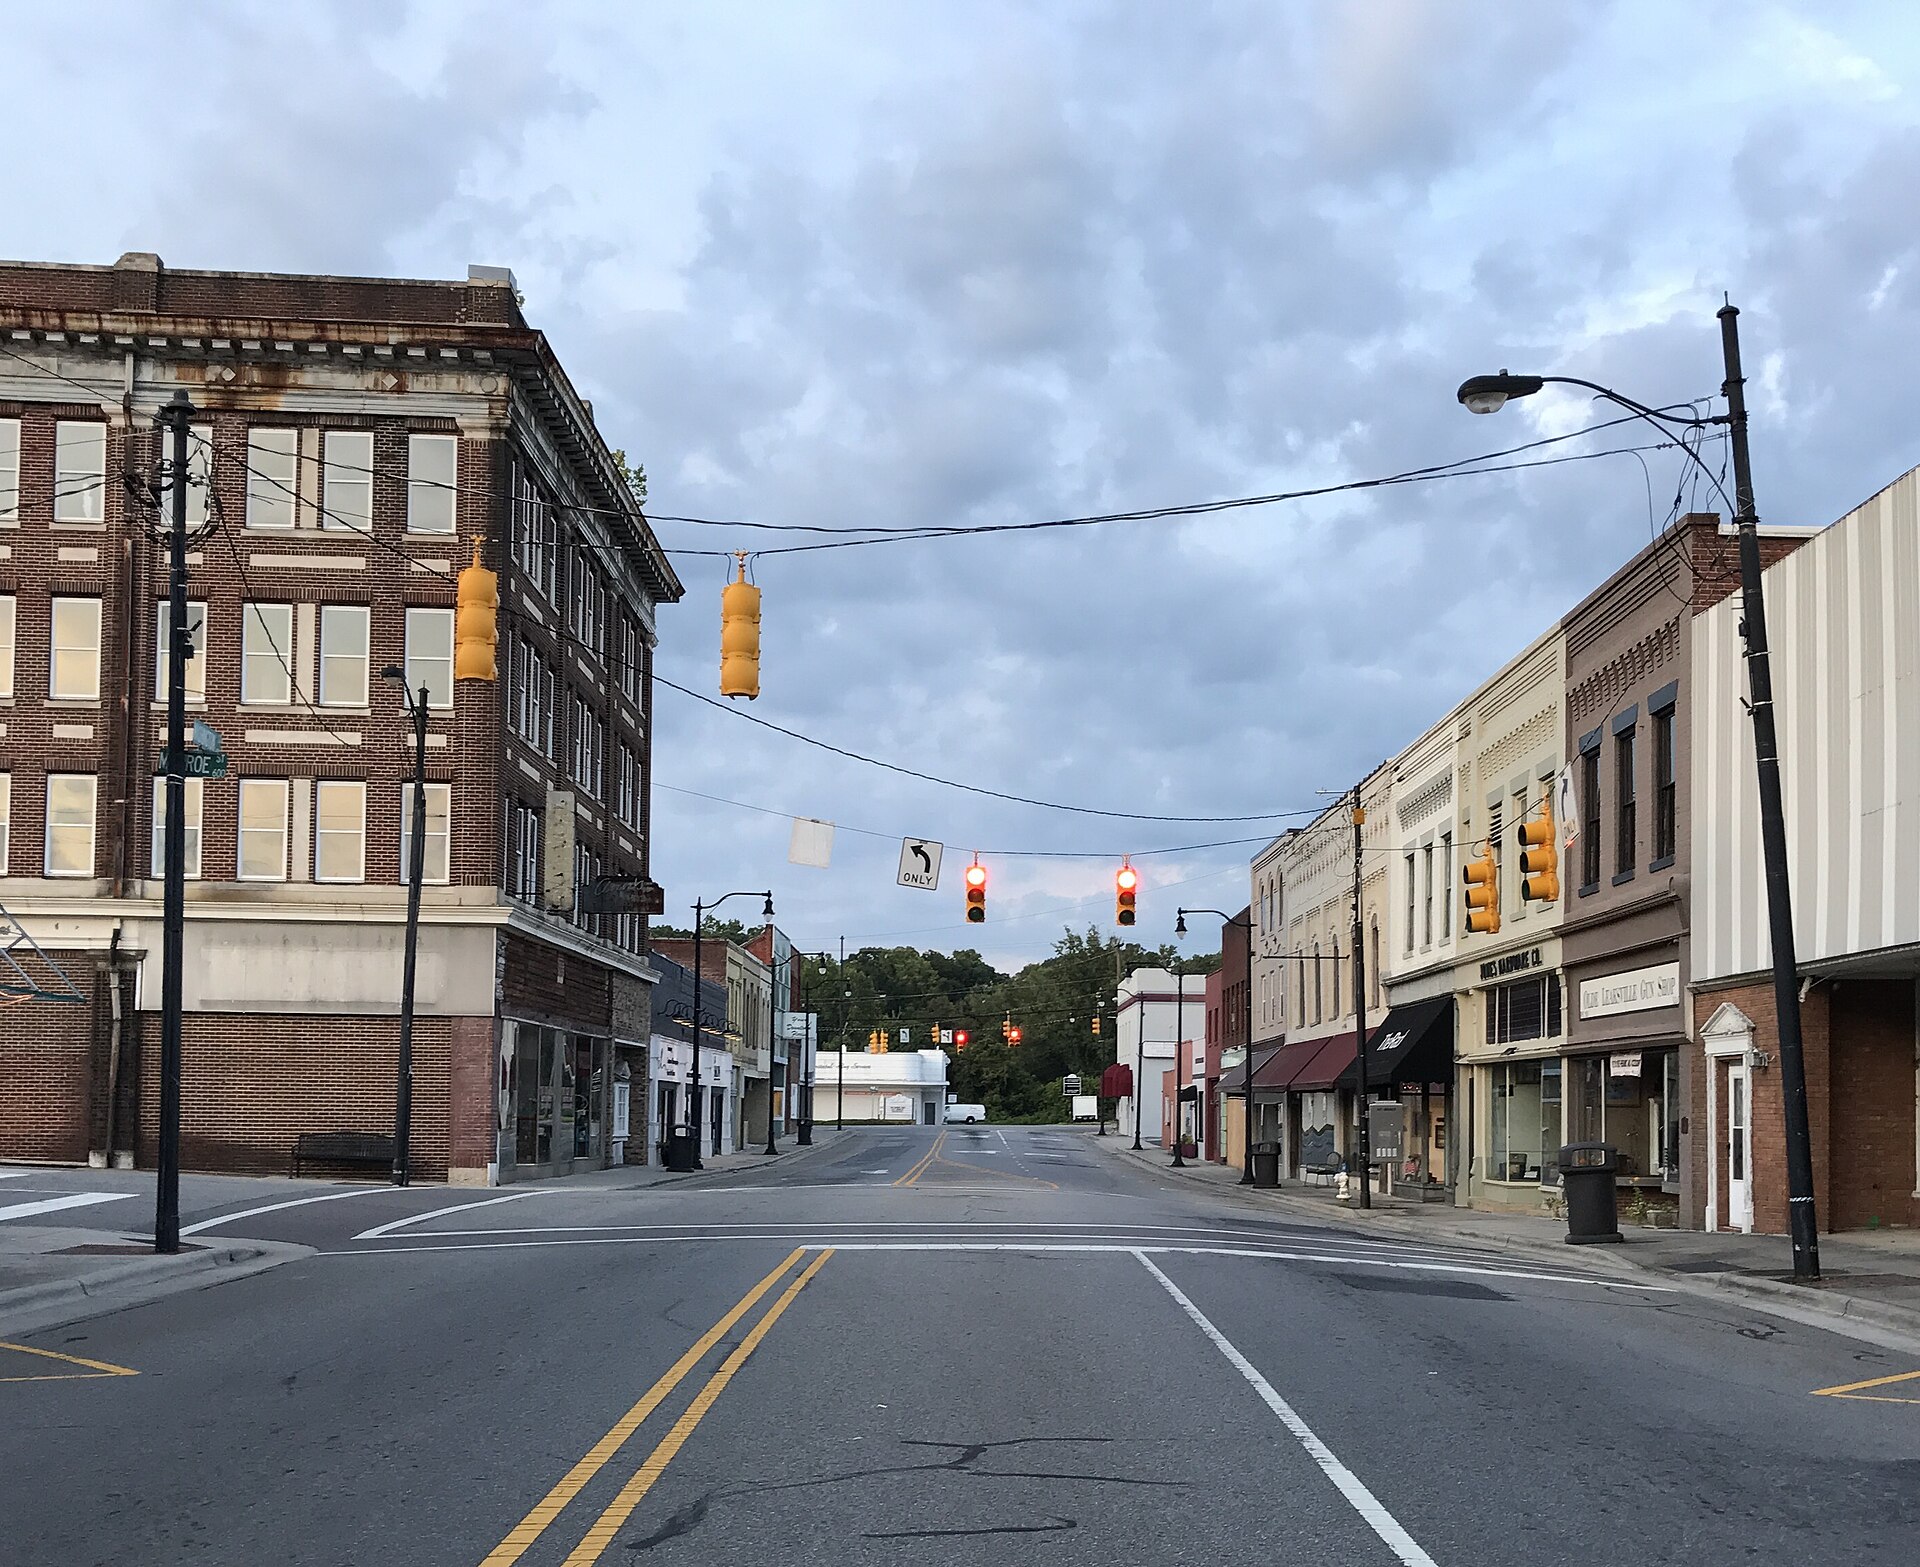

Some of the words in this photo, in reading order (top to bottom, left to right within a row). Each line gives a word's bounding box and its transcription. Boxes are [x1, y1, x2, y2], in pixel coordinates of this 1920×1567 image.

[159, 752, 211, 774] MROE
[216, 754, 226, 763] ST
[212, 768, 226, 779] 600
[903, 872, 933, 885] ONLY
[1657, 975, 1676, 997] SHOP
